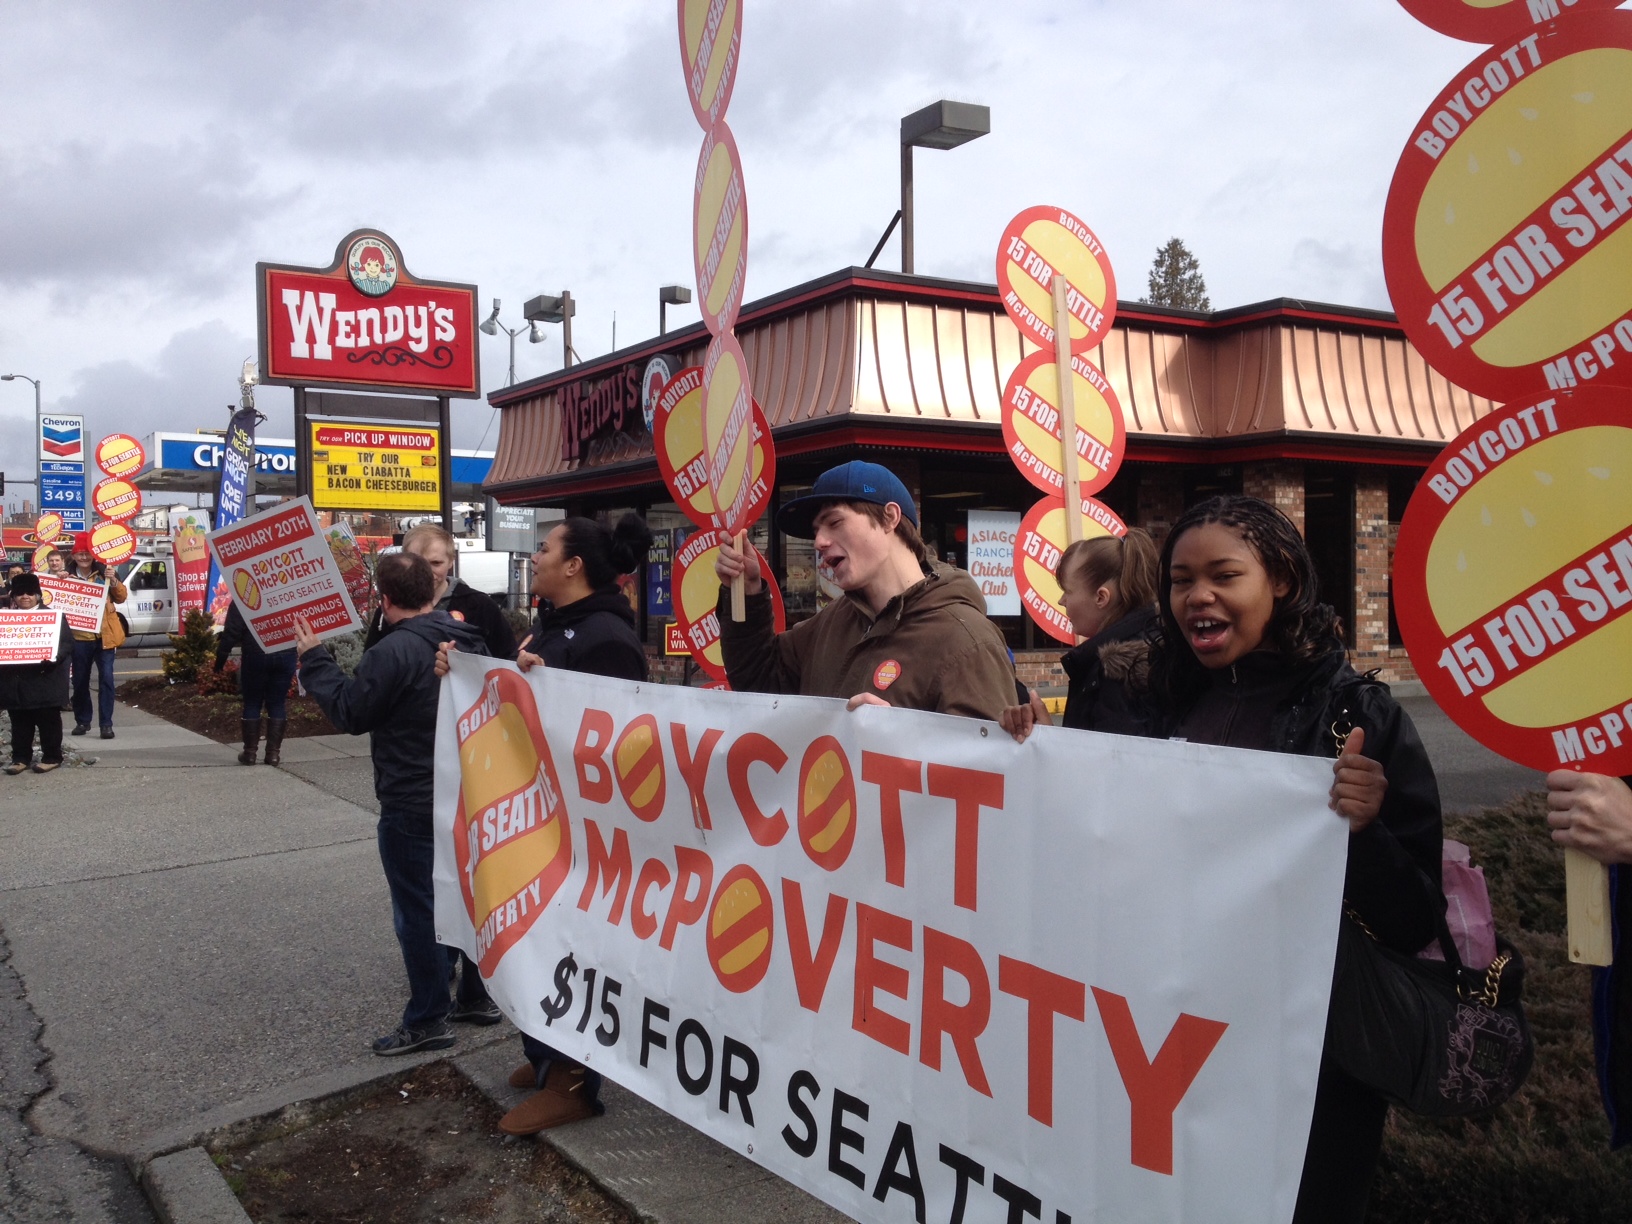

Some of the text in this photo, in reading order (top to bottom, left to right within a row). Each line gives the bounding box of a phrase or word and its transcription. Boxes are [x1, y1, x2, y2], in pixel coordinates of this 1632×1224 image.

[1414, 32, 1542, 160] BOYCOTT
[1059, 211, 1103, 257] BOYCOTT
[1006, 235, 1027, 262] 15
[1022, 250, 1053, 287] FOR
[1426, 284, 1485, 349] 15
[1471, 223, 1565, 314] FOR
[660, 369, 701, 413] BOYCOTT
[42, 417, 81, 427] Chevron
[1010, 385, 1032, 412] 15
[1027, 397, 1059, 433] FOR
[344, 432, 367, 444] PICK
[371, 434, 385, 444] UP
[388, 434, 431, 447] WINDOW
[1427, 398, 1560, 505] BOYCOTT
[327, 464, 411, 478] NEW CIABATTA
[357, 452, 399, 464] TRY OUR
[44, 490, 74, 501] 349
[328, 478, 437, 492] BACON CHEESEBURGER
[673, 470, 694, 499] 15
[495, 507, 535, 516] APPRECIATE
[499, 521, 530, 530] BUSINESS
[506, 514, 524, 522] YOUR
[217, 514, 309, 559] FEBRUARY 20TH
[678, 530, 717, 569] BOYCOTT
[1022, 531, 1042, 558] 15
[251, 547, 305, 576] BOYCOTT
[648, 549, 670, 563] UNTIL
[39, 578, 102, 595] FEBRUARY 20TH
[178, 571, 208, 582] Shop at
[257, 556, 326, 591] McPOVERTY
[54, 597, 100, 609] McPOVERTY
[55, 592, 92, 603] BOYCOTT
[266, 597, 279, 608] $15
[278, 593, 297, 605] FOR
[296, 578, 334, 598] SEATTLE
[656, 586, 663, 604] 2
[981, 580, 1008, 597] Club
[253, 598, 343, 632] DON'T EAT AT McDONALD'S
[259, 629, 284, 643] BURGER
[310, 610, 349, 629] WENDY'S
[688, 622, 707, 651] 15
[1437, 633, 1496, 697] 15
[1482, 588, 1577, 671] FOR
[572, 706, 1005, 913] BOYCOTT
[576, 817, 1230, 1176] McPOVERTY
[541, 952, 623, 1047] $15
[639, 996, 760, 1129] FOR
